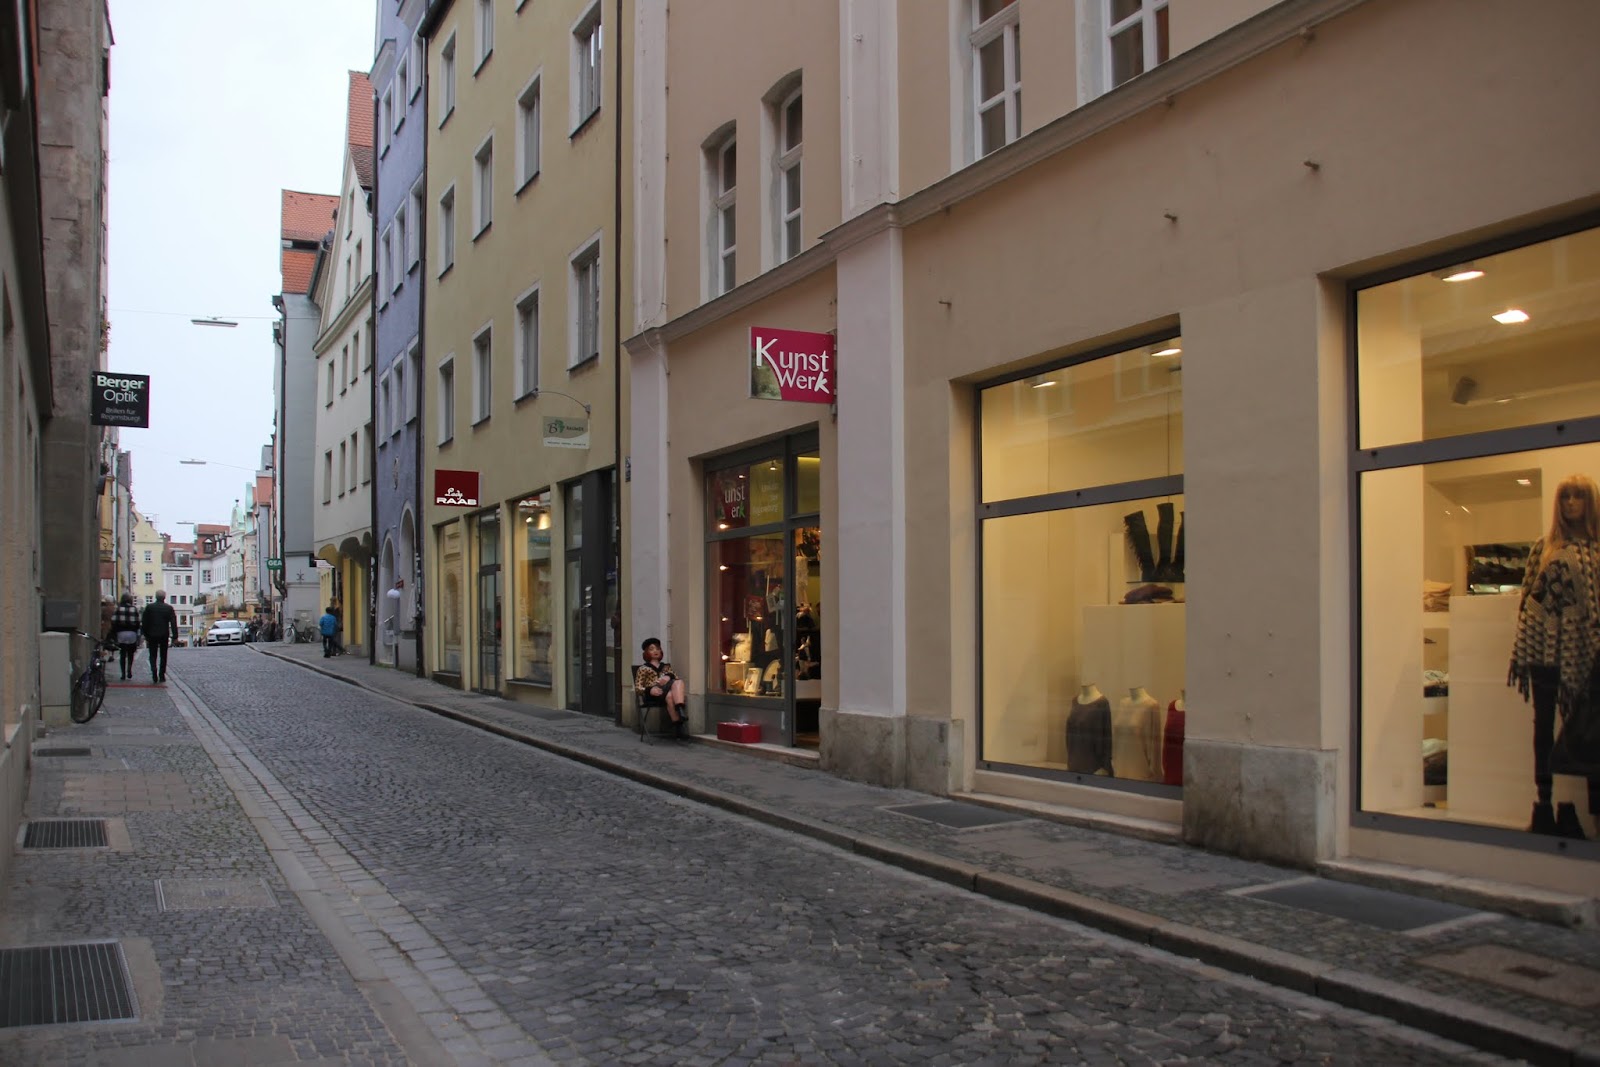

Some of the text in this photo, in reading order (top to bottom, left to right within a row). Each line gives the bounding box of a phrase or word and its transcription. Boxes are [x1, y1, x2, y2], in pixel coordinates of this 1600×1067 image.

[756, 336, 830, 373] Kunst
[96, 375, 145, 392] Berger
[779, 368, 830, 394] Werk
[103, 389, 138, 404] Optik
[436, 496, 477, 506] RAAB
[444, 487, 463, 500] Lady
